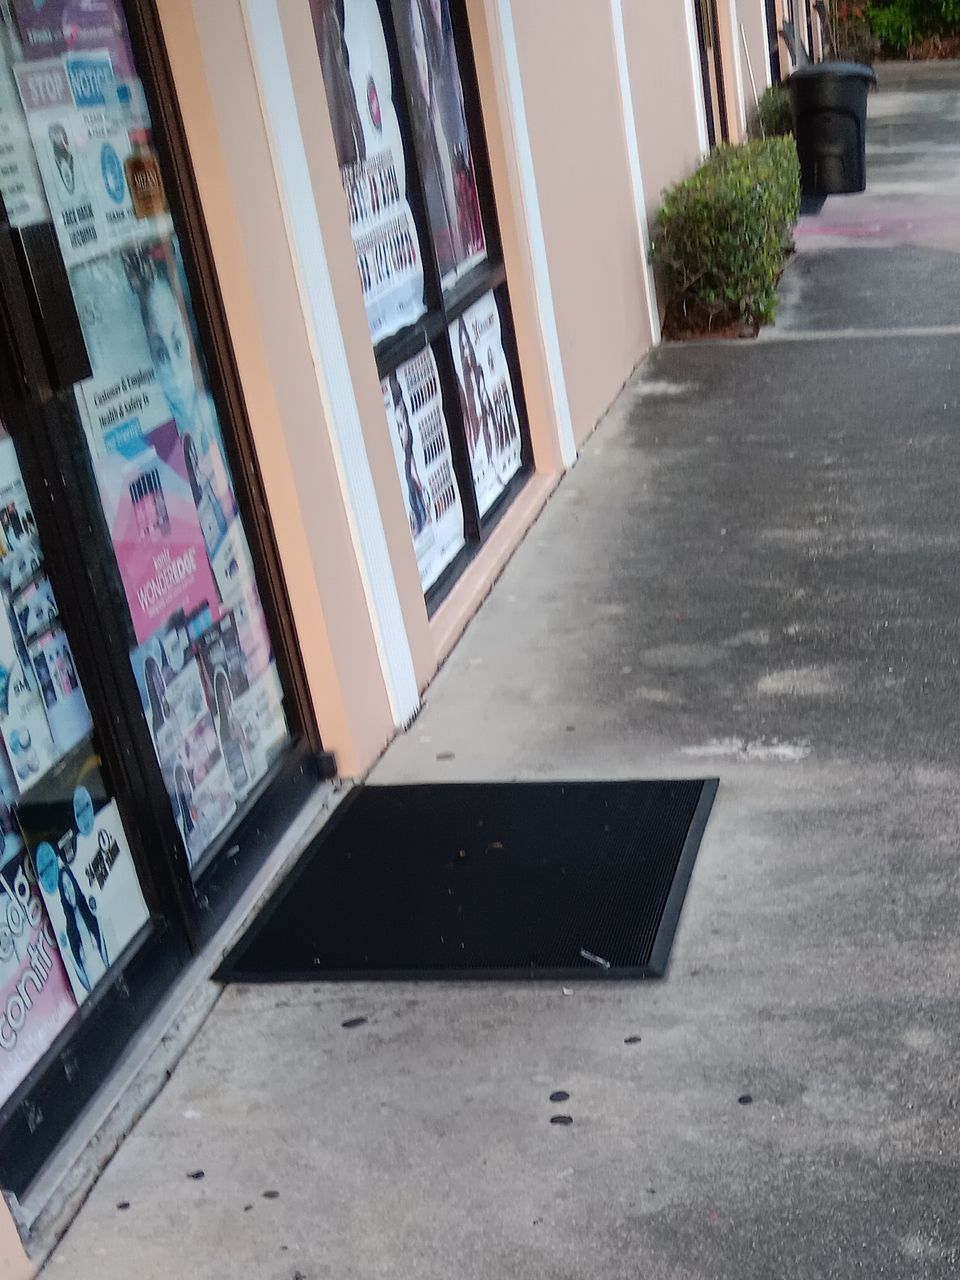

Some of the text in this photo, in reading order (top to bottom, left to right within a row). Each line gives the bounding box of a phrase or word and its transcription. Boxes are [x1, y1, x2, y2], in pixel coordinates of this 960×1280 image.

[27, 73, 64, 105] STOP
[70, 66, 112, 99] NOTICE
[62, 208, 77, 226] FACE
[94, 384, 121, 406] Customer
[98, 407, 118, 429] Health
[124, 398, 143, 415] Safety
[136, 547, 196, 612] WONDEREDGE
